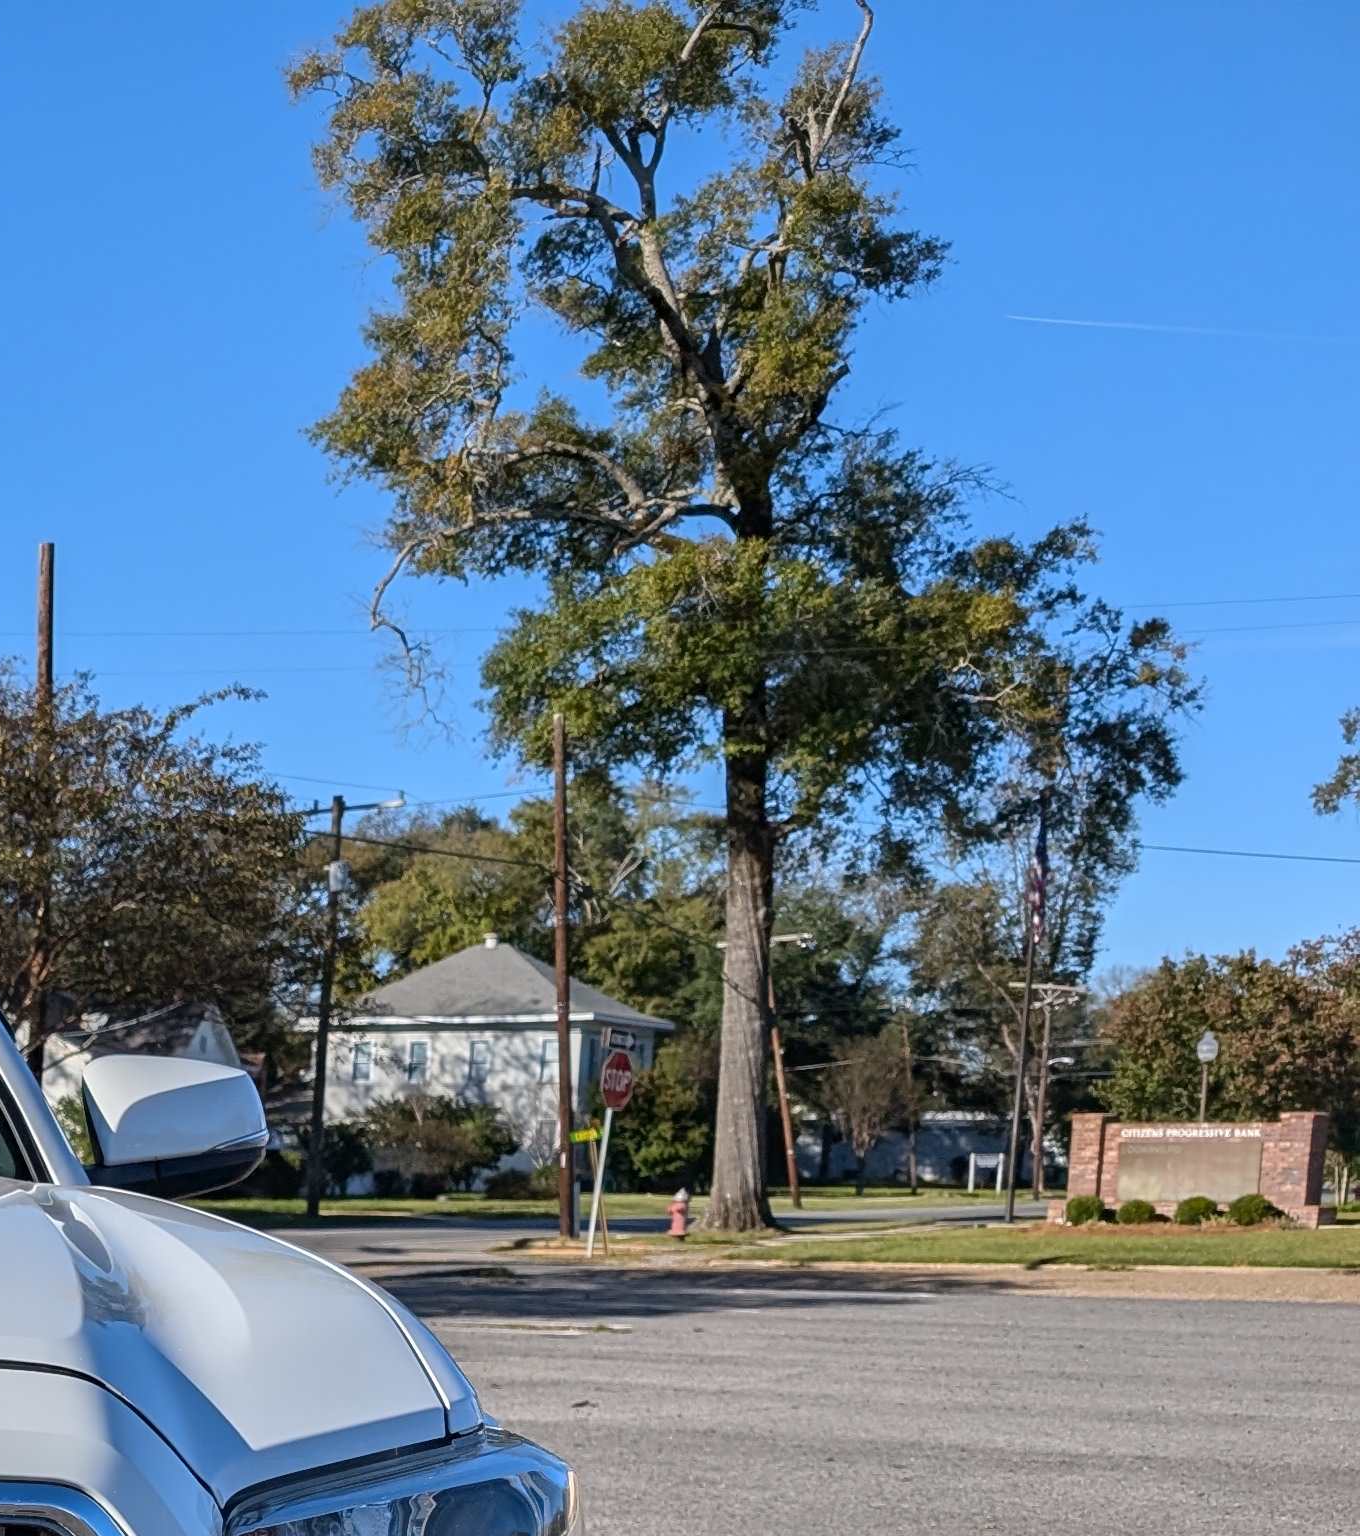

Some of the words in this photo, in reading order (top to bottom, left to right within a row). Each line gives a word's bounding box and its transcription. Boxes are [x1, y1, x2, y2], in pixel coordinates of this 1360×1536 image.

[604, 1069, 632, 1092] STOP
[1121, 1127, 1164, 1138] CITIZENS
[1166, 1127, 1232, 1138] PROGRESSIVE
[1234, 1127, 1261, 1138] BANK
